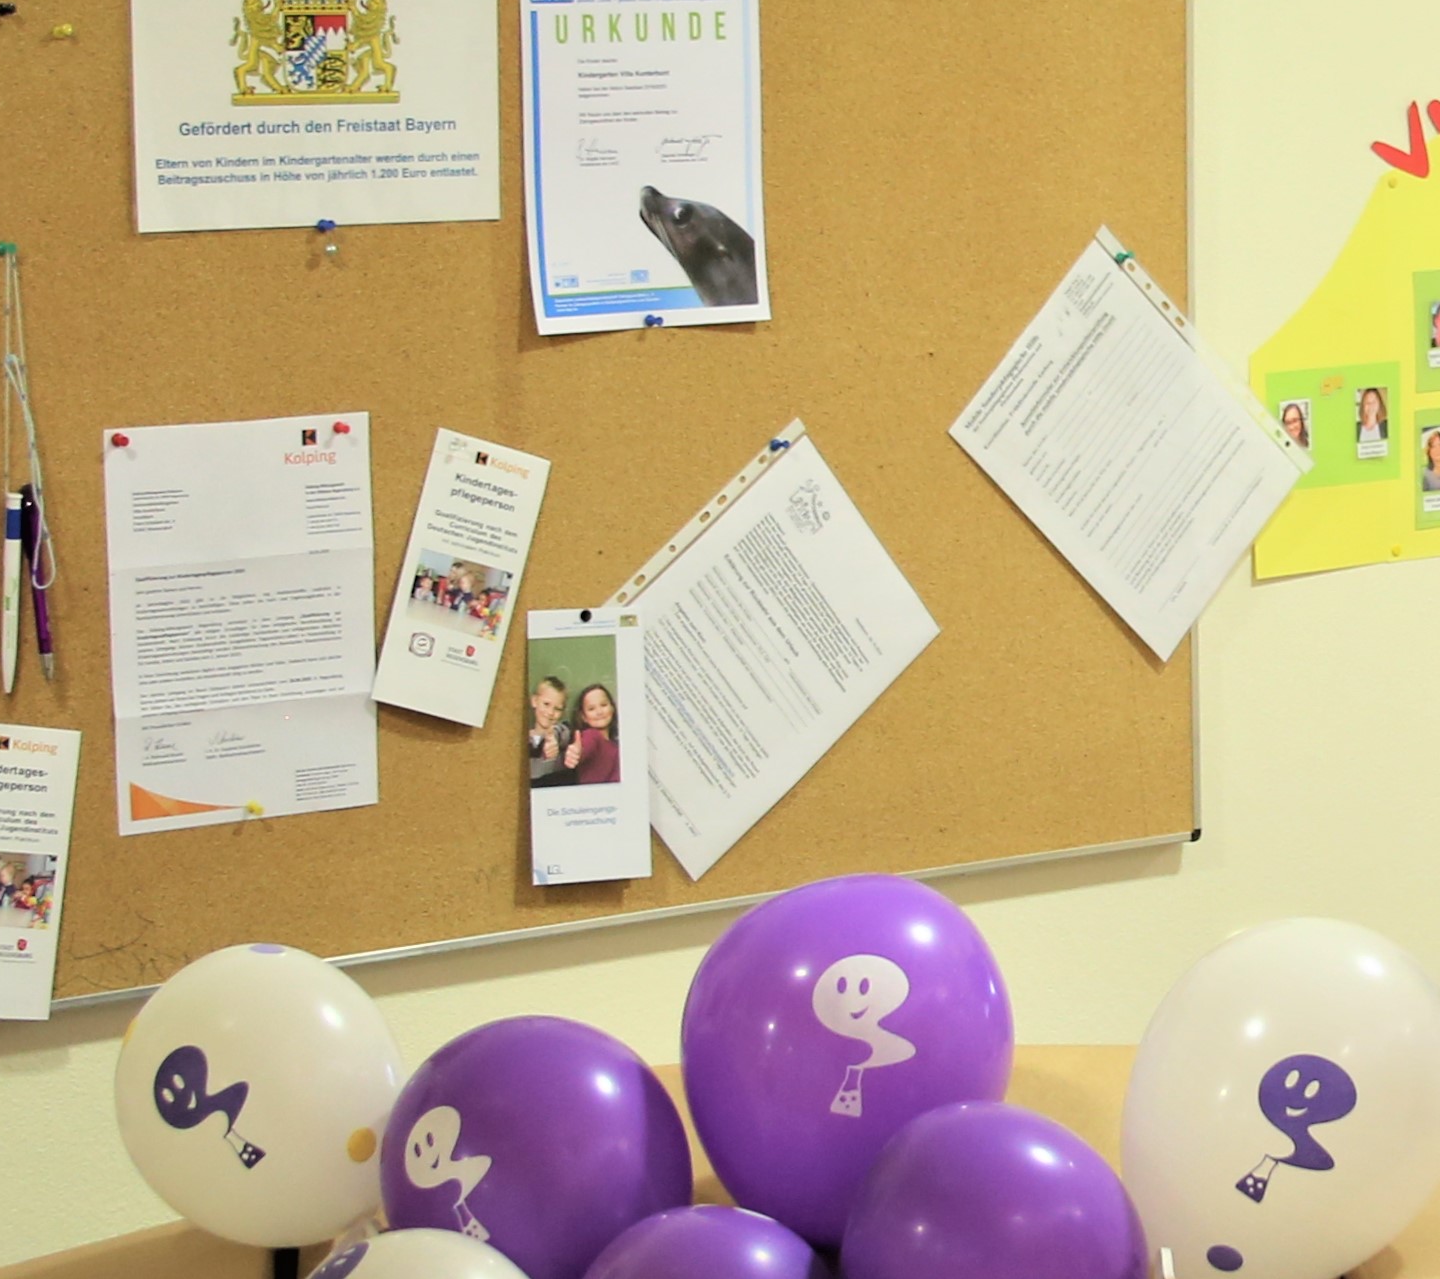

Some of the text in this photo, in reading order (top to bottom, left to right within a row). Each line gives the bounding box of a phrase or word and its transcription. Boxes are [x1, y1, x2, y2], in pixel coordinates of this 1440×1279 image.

[555, 11, 726, 44] URKUNDE
[179, 118, 457, 136] Gefördert durch den Freistaat Bayern
[155, 152, 480, 169] Eltern von Kindern im Kindergartenalter werden durch einen
[157, 166, 477, 186] Beitragszuschuss in Höhe von jährlich 1.200 Euro entlastet.
[284, 449, 337, 466] Kolping
[490, 457, 530, 480] Kolping
[455, 473, 518, 497] Kindertages-
[450, 488, 515, 512] pflegeperson
[12, 740, 58, 756] Kolping
